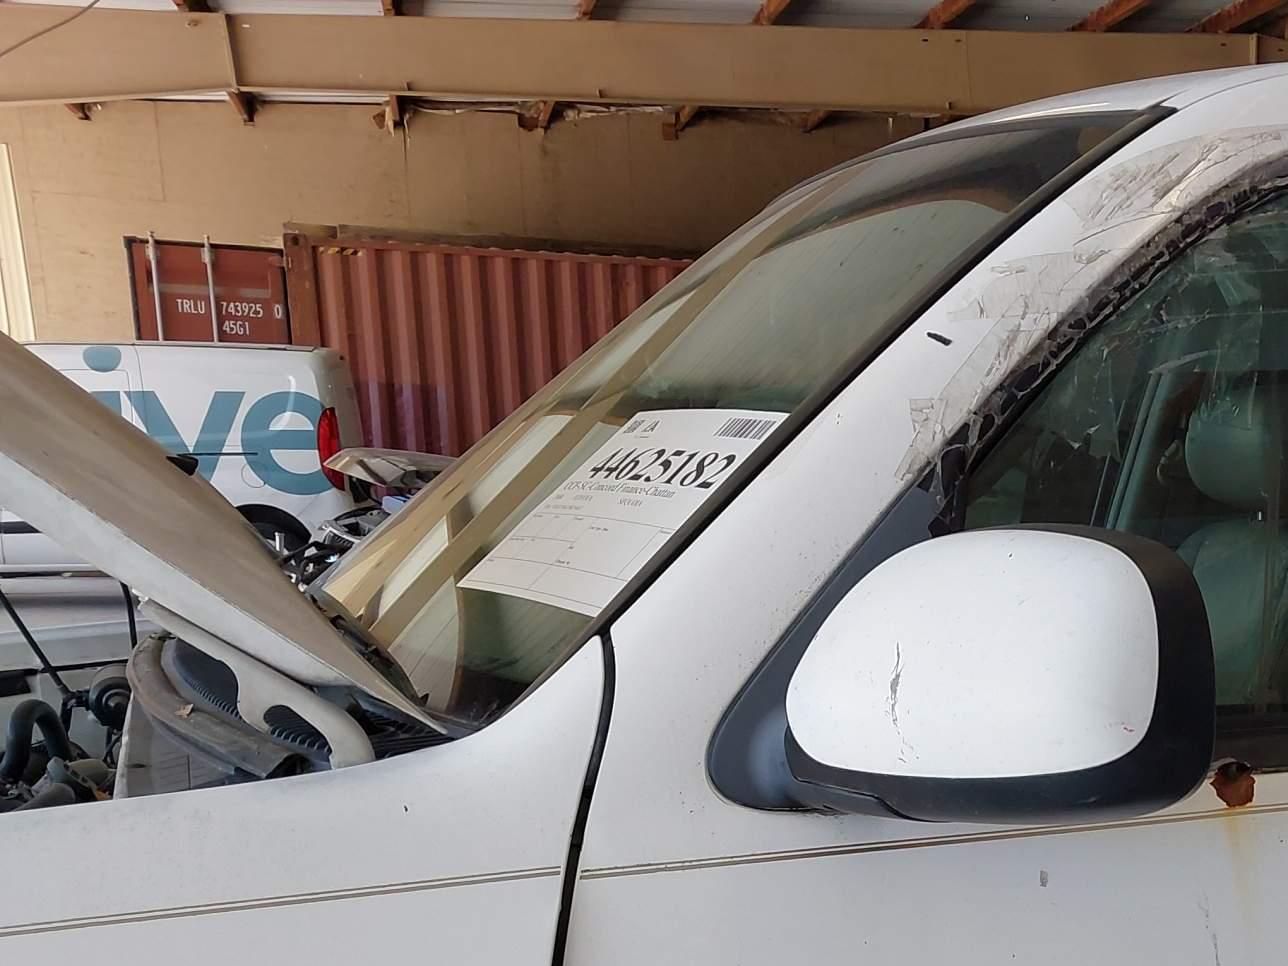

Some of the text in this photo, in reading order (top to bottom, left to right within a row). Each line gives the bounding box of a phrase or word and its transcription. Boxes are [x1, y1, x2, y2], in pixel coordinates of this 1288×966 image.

[176, 299, 282, 319] TRLU 743925 0
[222, 320, 250, 335] 45G1
[589, 447, 737, 489] 44625182
